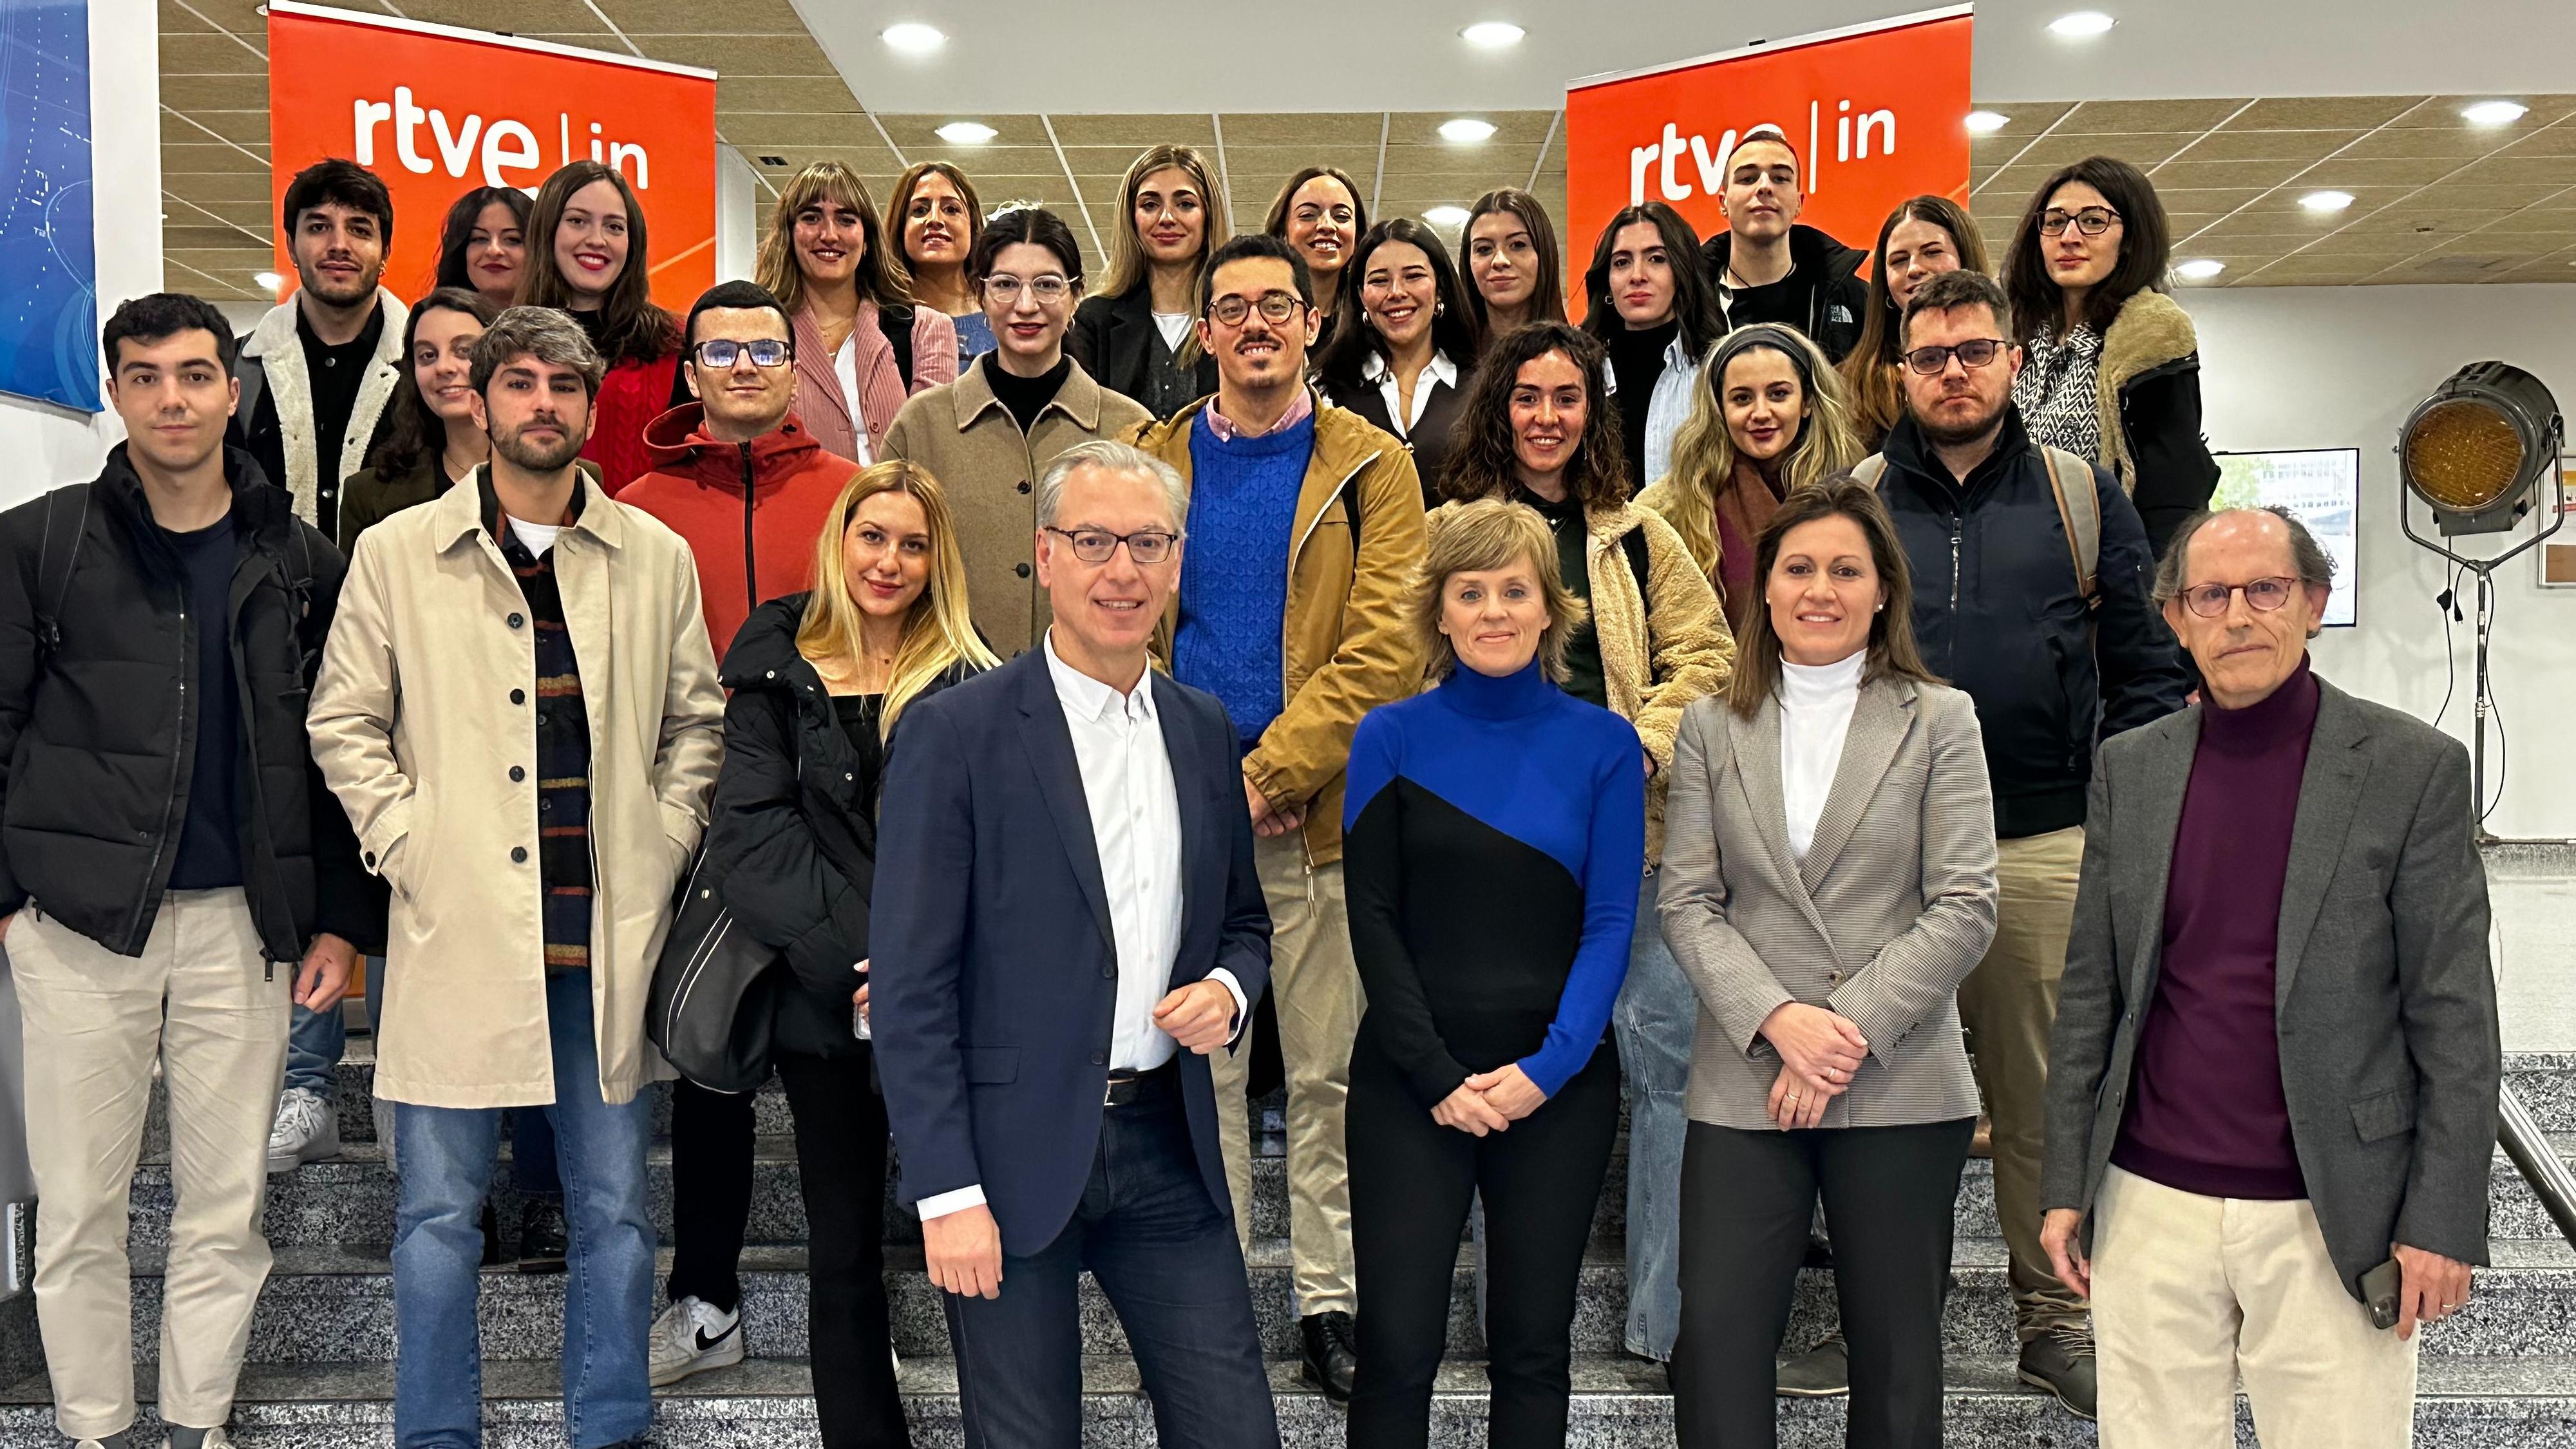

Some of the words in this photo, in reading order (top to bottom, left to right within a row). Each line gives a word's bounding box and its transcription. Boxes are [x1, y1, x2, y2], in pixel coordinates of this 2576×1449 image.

[354, 86, 540, 201] rtve
[590, 122, 649, 189] in
[1631, 123, 1786, 207] rtv
[1837, 100, 1895, 162] in
